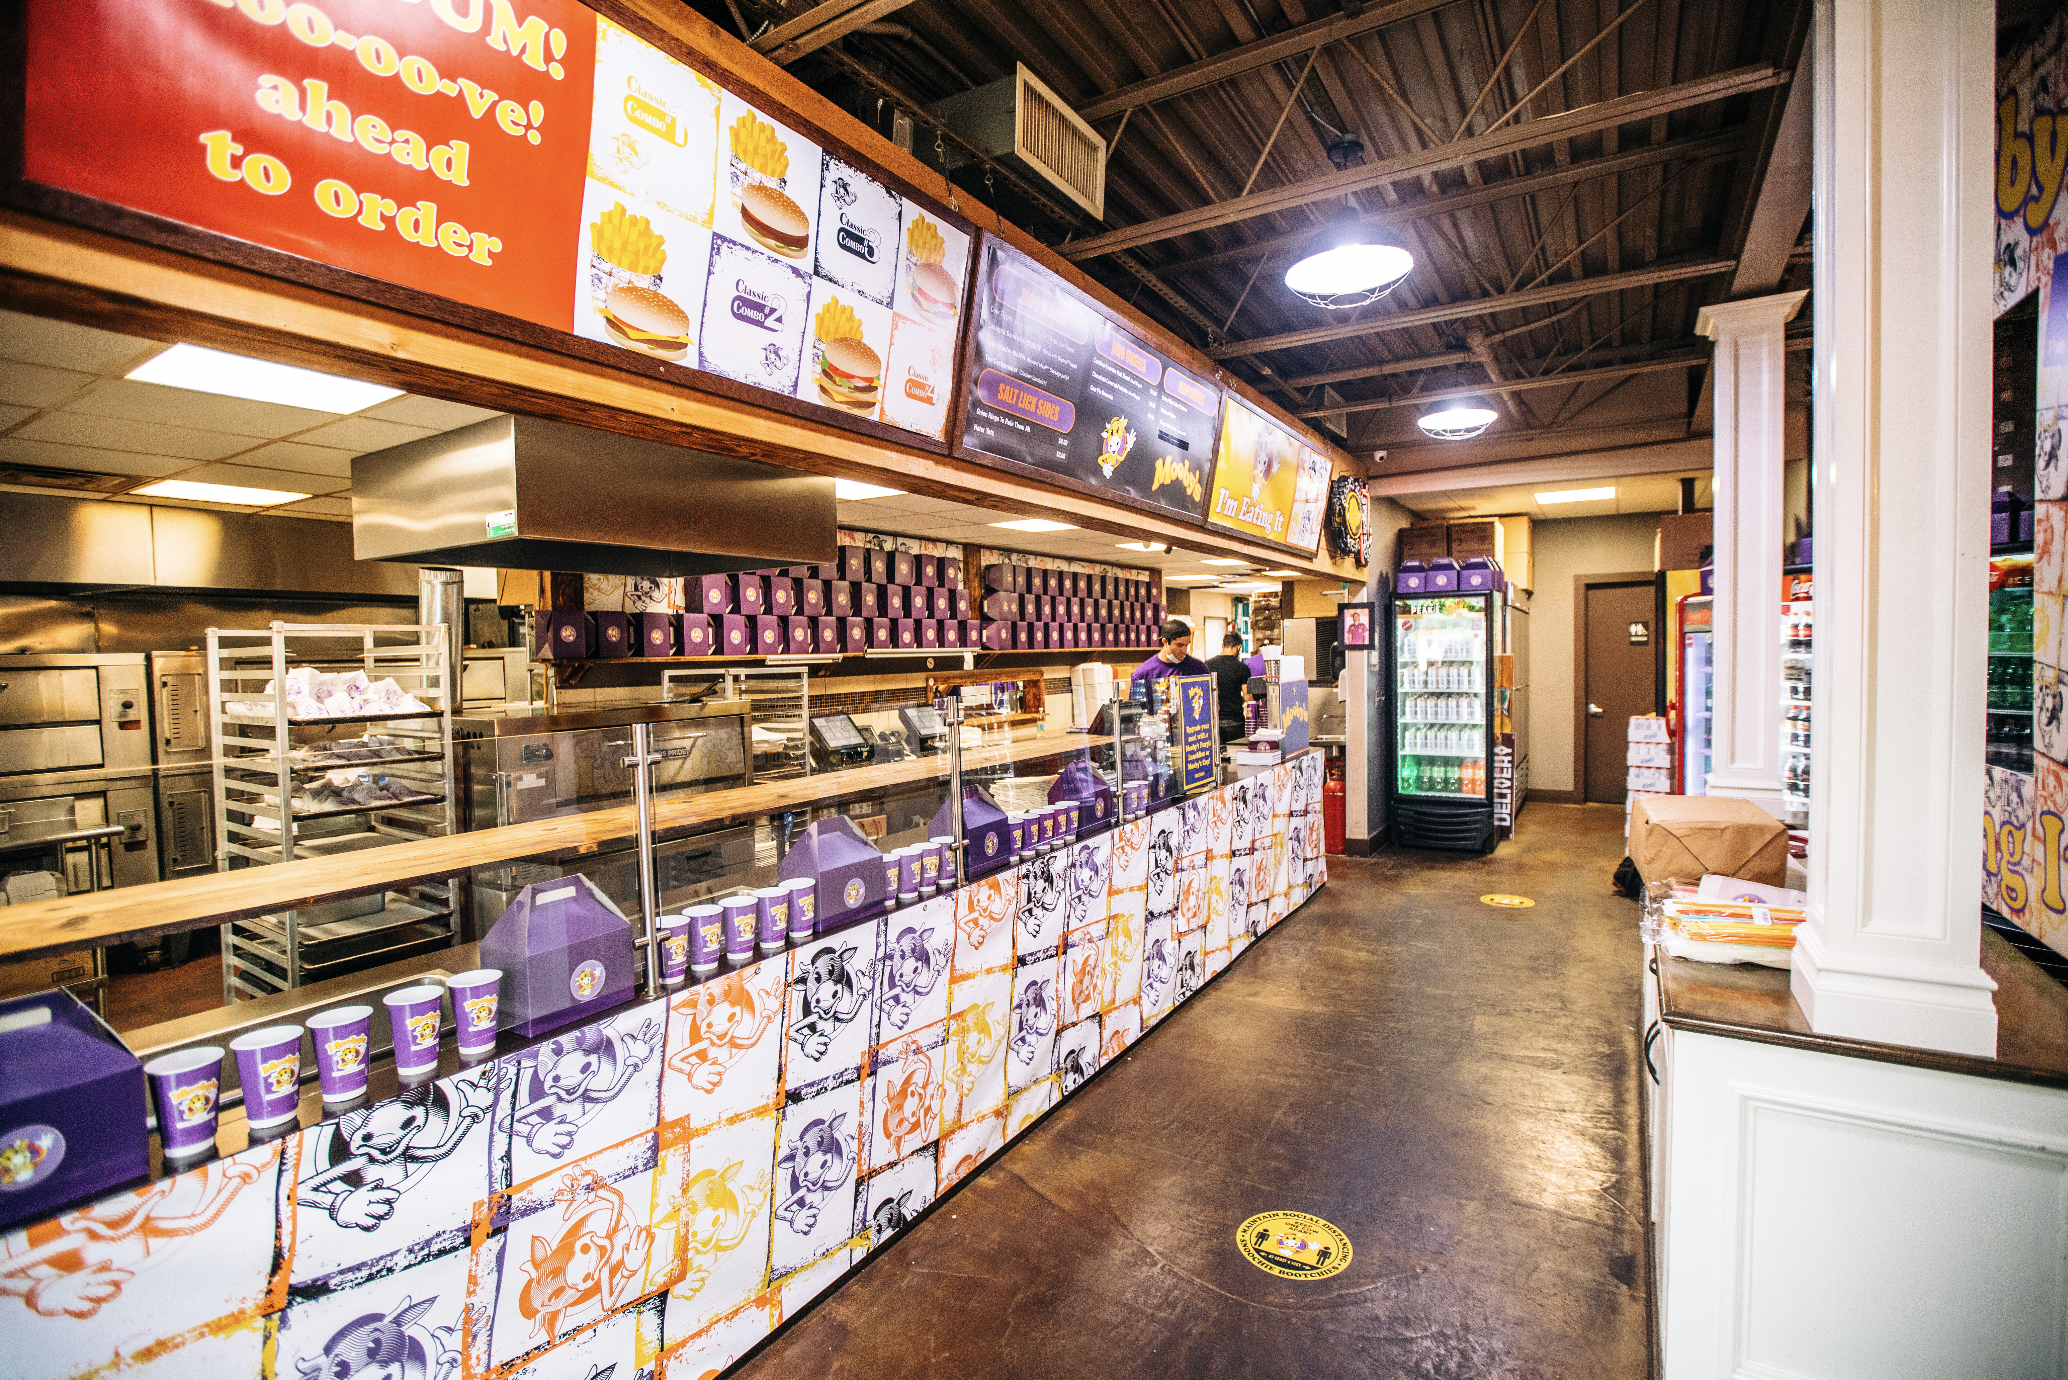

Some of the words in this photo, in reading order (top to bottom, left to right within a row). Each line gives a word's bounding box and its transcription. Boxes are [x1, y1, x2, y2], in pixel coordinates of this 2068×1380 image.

[403, 0, 567, 80] UM!
[206, 0, 544, 145] oo-oo-ve!
[627, 75, 668, 110] Classic
[256, 74, 469, 186] ahead
[200, 130, 291, 195] to
[315, 179, 502, 265] order
[840, 212, 867, 236] Classic
[736, 279, 768, 302] Classic
[908, 365, 929, 382] Classic
[997, 383, 1019, 405] SALT
[1018, 391, 1038, 413] LICK
[1037, 399, 1060, 421] SIDES
[1152, 454, 1203, 503] Mooby's
[1216, 487, 1238, 518] I'm
[1238, 496, 1274, 535] Eating
[1274, 509, 1285, 533] It
[1282, 701, 1308, 735] Mooby's
[1494, 745, 1512, 827] DELIVERY
[1240, 1238, 1277, 1272] SNOOCHIE
[1278, 1266, 1340, 1279] BOOTCHIES
[1241, 1212, 1280, 1234] MAINTAIN
[1282, 1212, 1320, 1225] SOCIAL
[1322, 1223, 1350, 1264] DISTANCING
